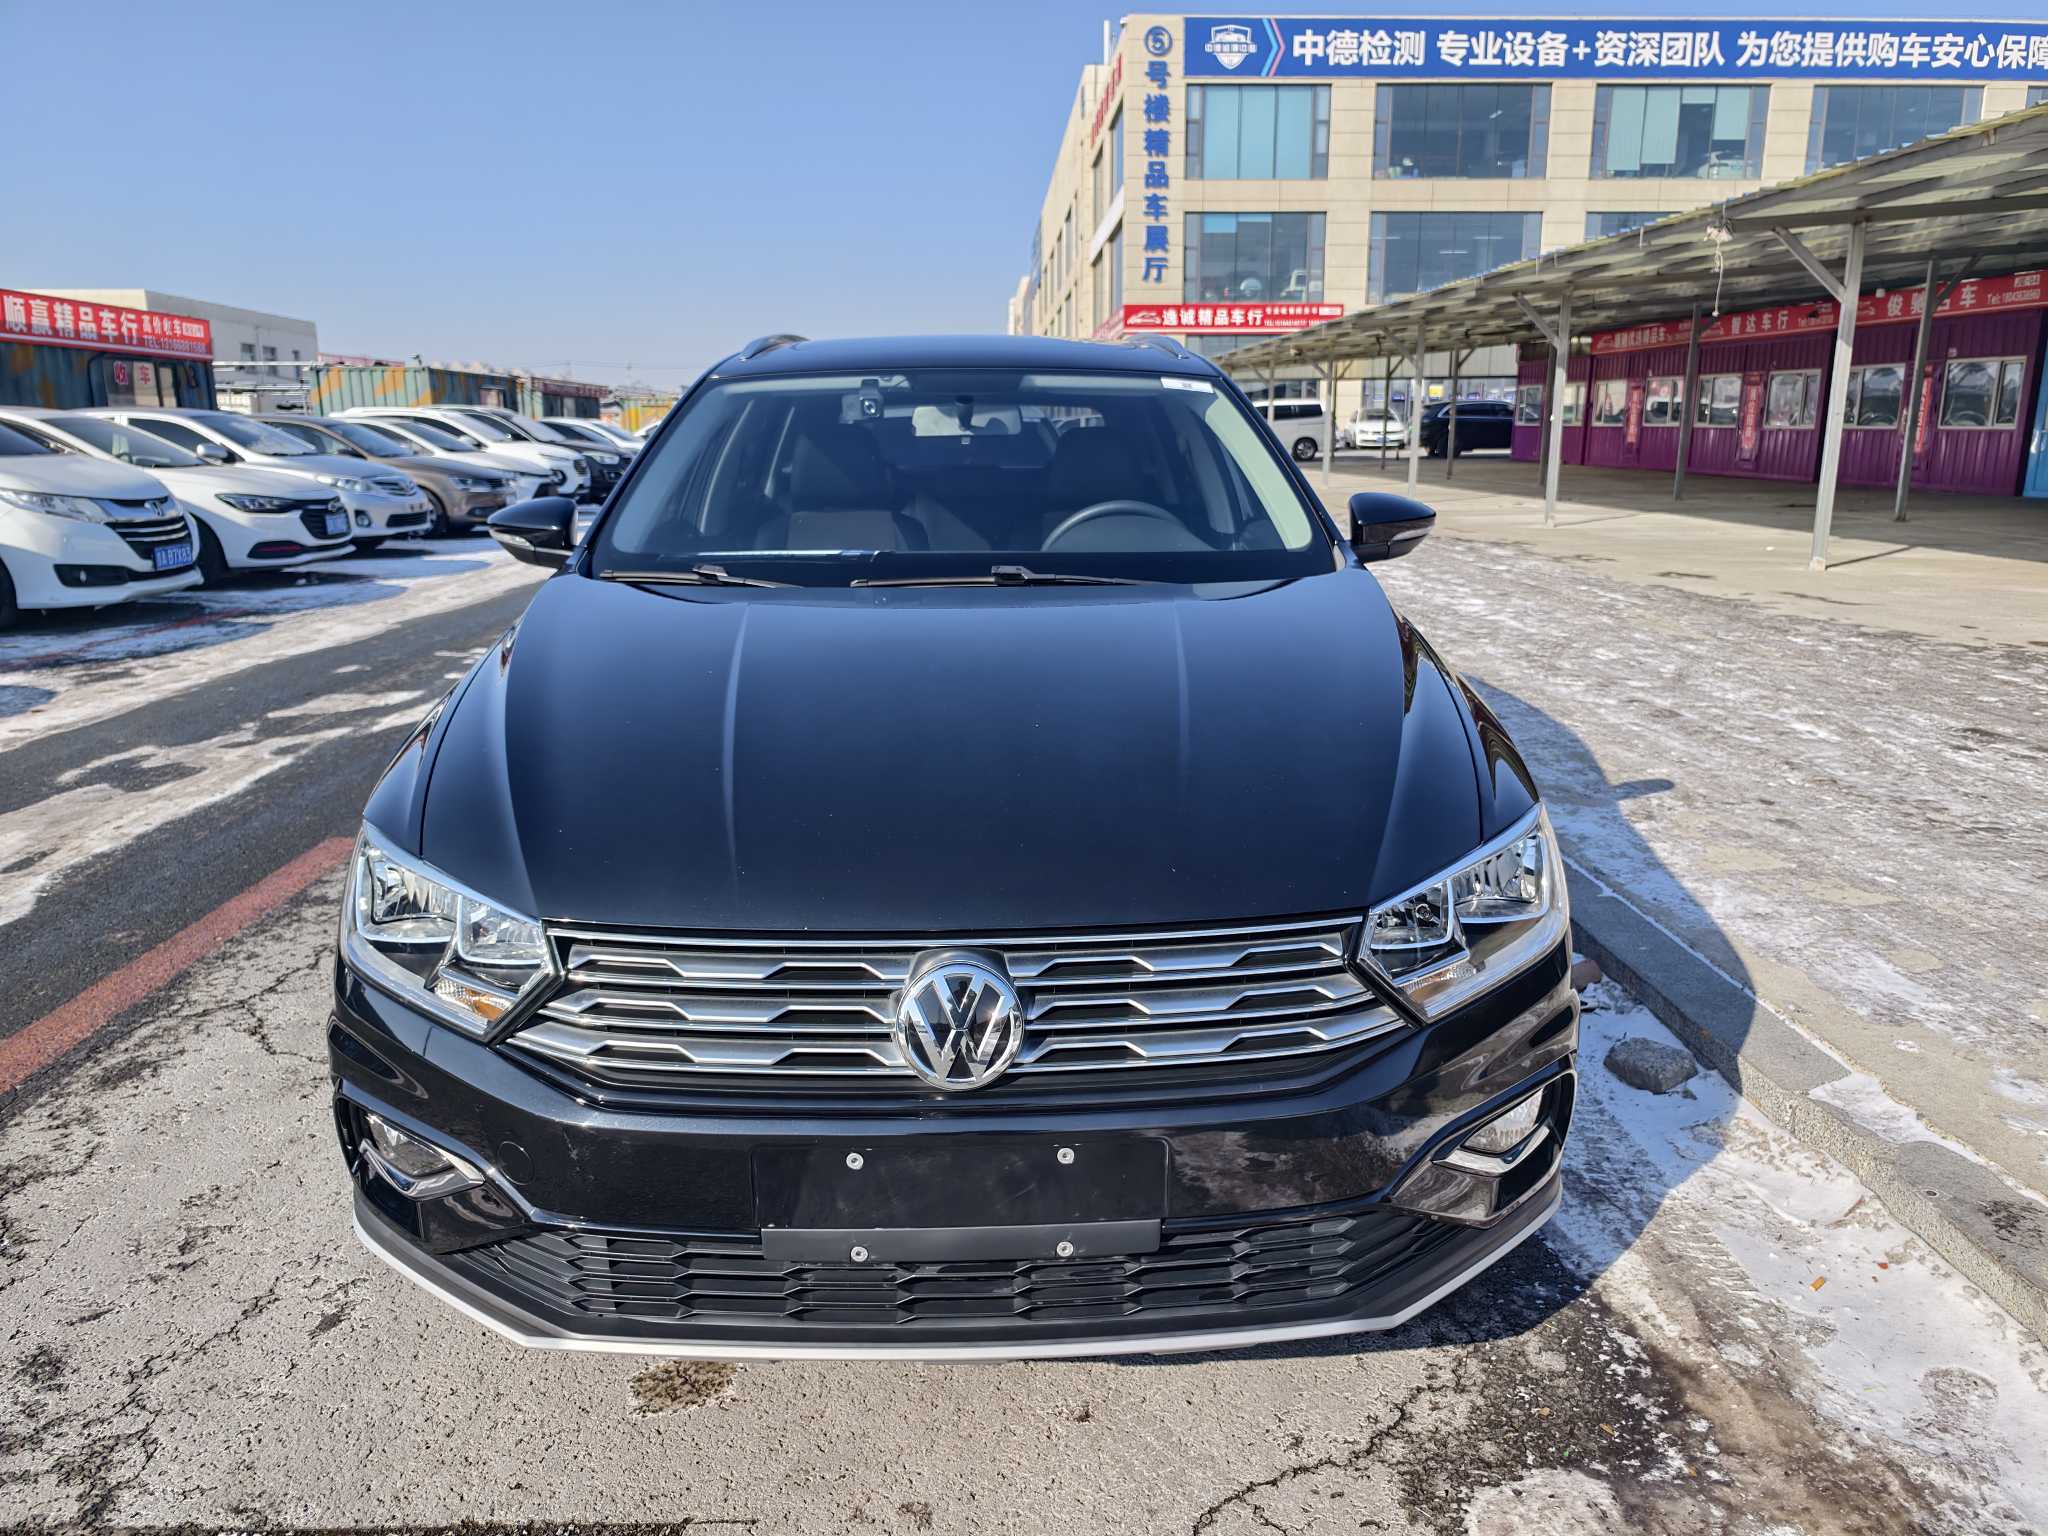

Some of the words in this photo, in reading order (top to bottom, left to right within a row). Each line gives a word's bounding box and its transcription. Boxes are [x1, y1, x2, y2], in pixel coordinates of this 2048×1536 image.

[1292, 29, 1427, 67] 中德检测
[1436, 30, 1725, 68] 专业设备+资深团队
